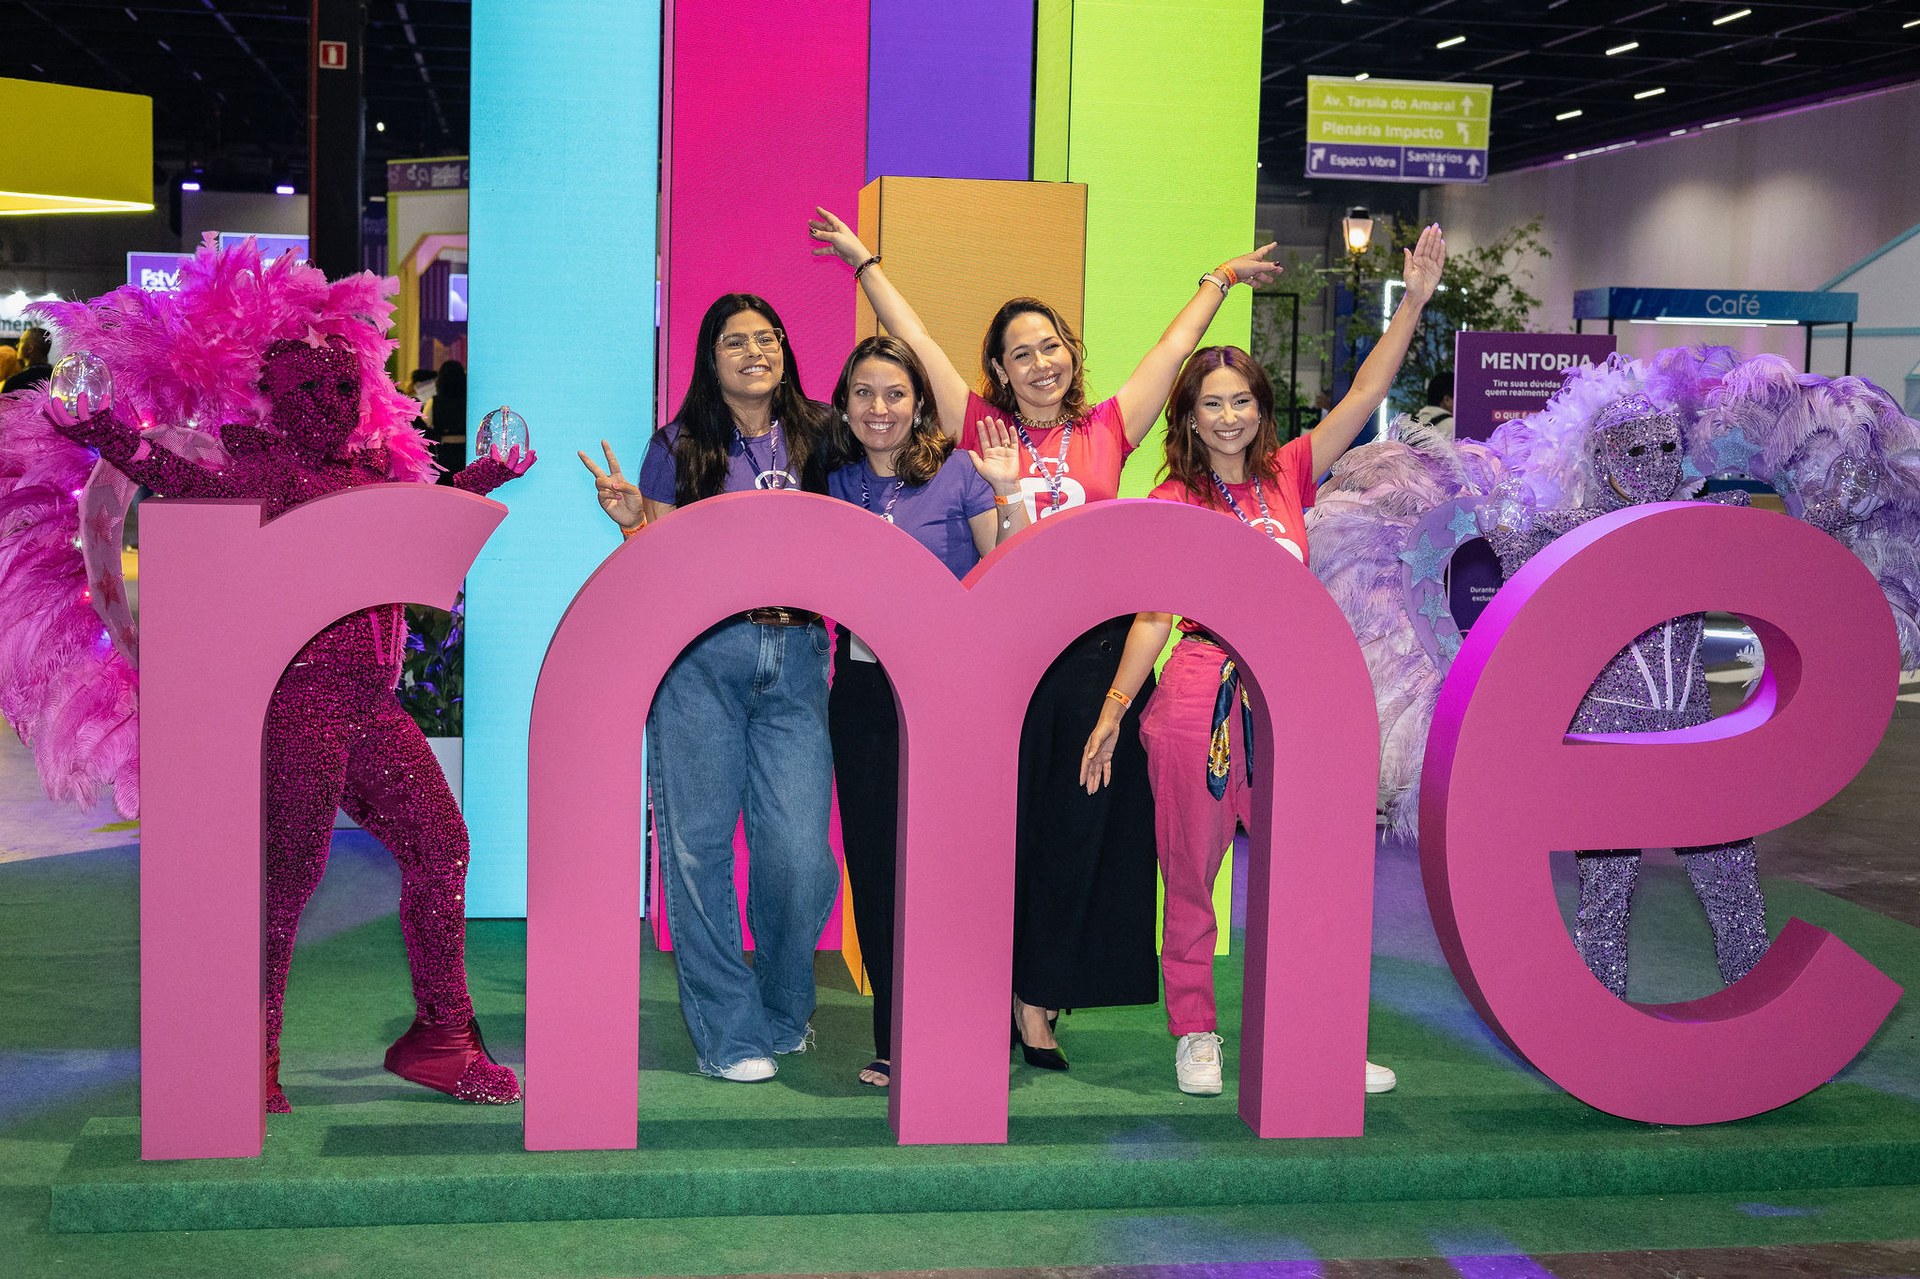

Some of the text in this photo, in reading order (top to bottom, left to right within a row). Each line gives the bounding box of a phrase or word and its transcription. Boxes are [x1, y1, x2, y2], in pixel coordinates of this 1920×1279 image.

[1323, 95, 1455, 112] Av. Tarsila do Amaral
[1322, 121, 1444, 140] Plenária Impacto
[1329, 154, 1396, 168] Espaço Vibra
[1407, 151, 1463, 165] Sanitários
[1705, 293, 1760, 316] Café
[1481, 352, 1591, 371] MENTORIA
[1493, 380, 1509, 388] Tire
[1530, 379, 1561, 389] dúvidas
[1485, 389, 1508, 398] quem
[1509, 389, 1550, 398] realmente
[1494, 412, 1501, 420] O
[1503, 412, 1521, 420] QUE
[138, 484, 1903, 1161] rme
